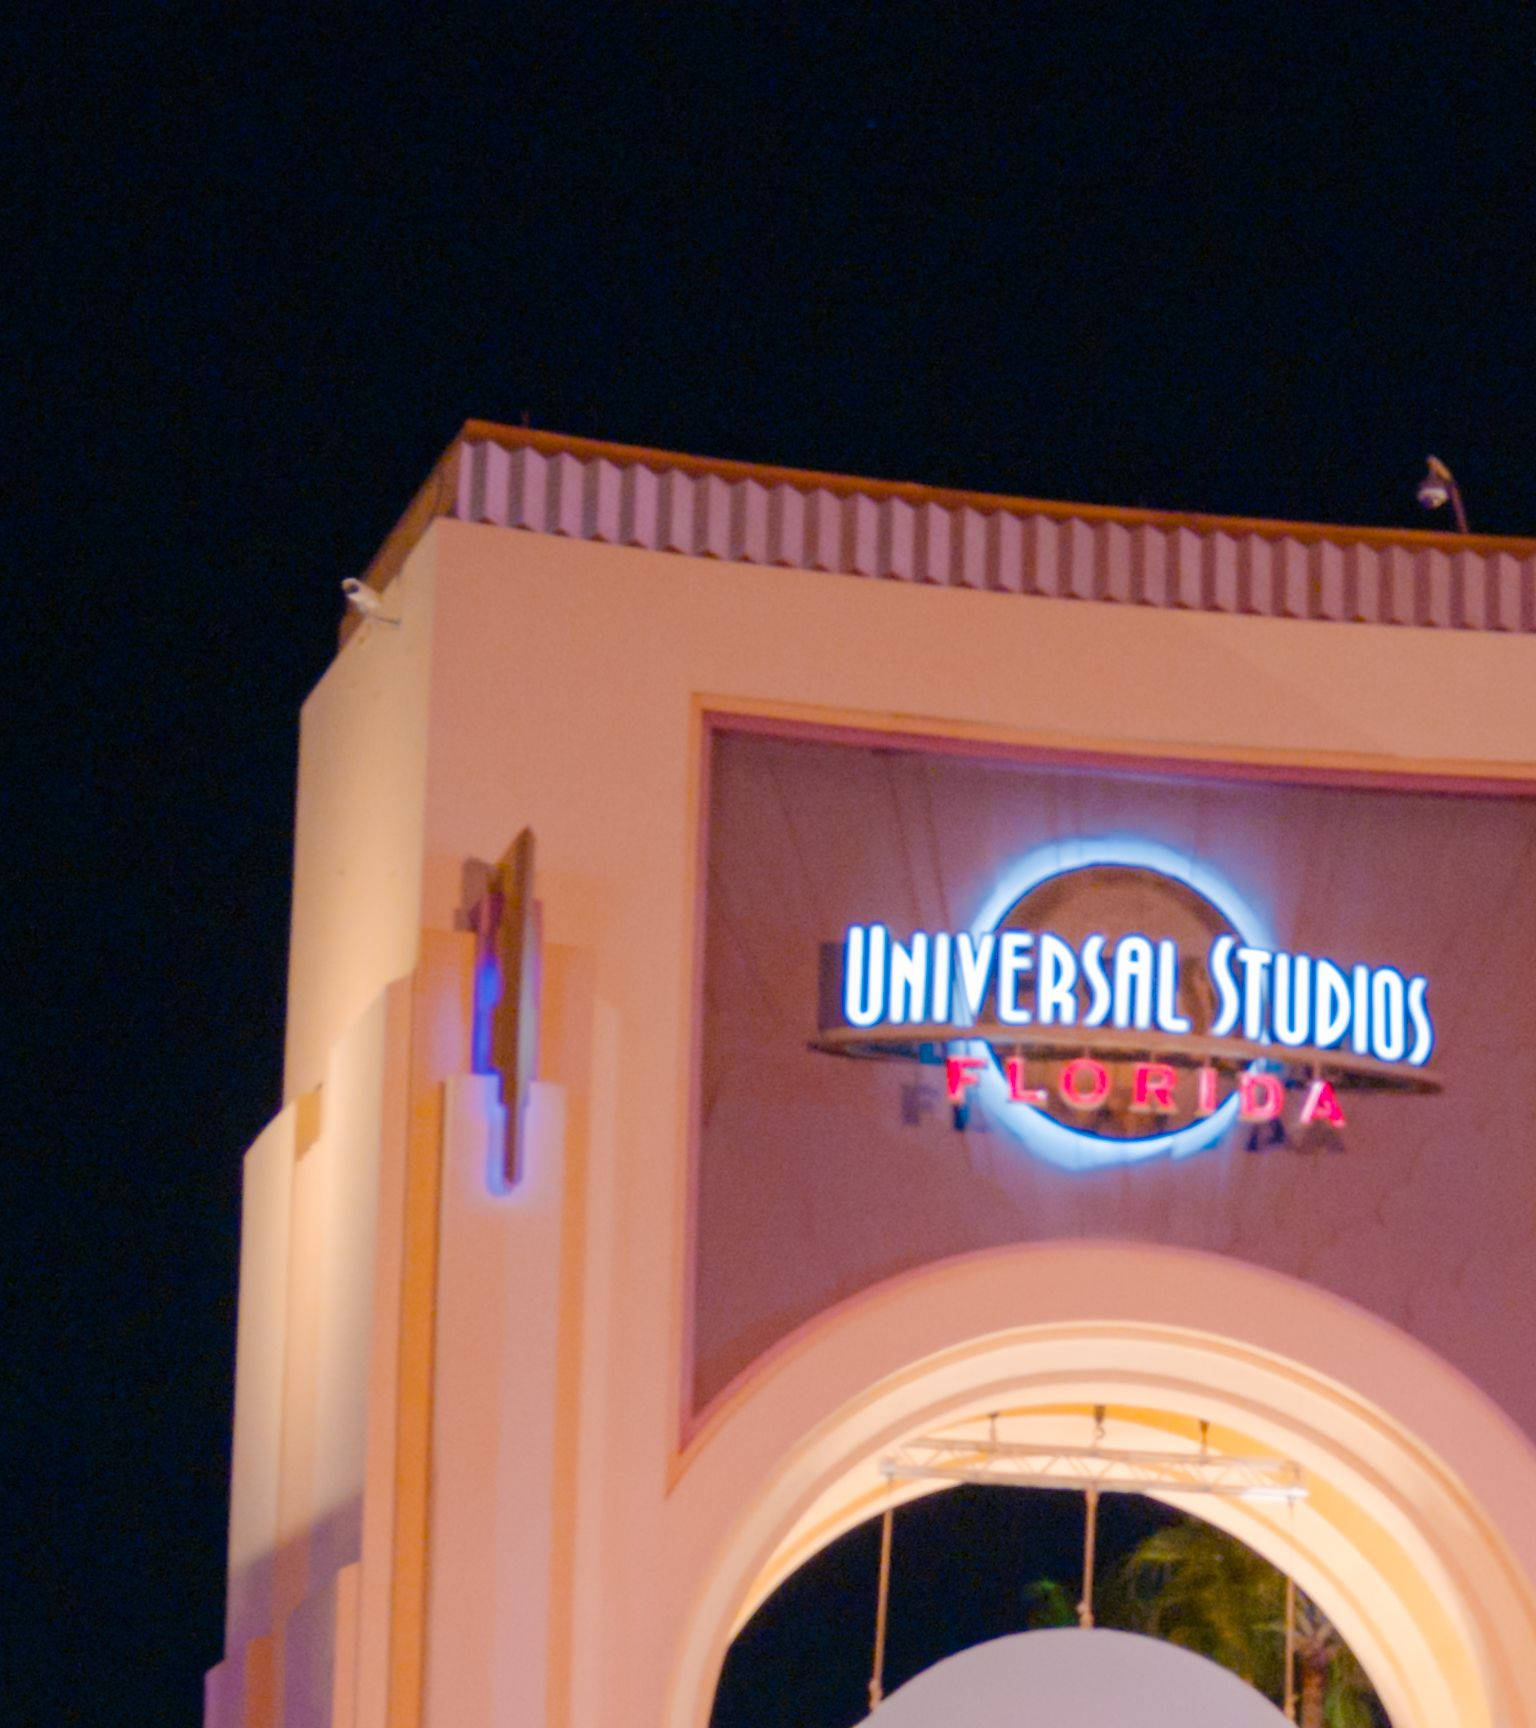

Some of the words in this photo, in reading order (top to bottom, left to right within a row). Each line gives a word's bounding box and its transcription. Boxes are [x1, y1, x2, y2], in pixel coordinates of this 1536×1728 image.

[843, 923, 1190, 1034] UNIVERSAL
[1208, 935, 1435, 1066] STUDIOS
[945, 1056, 1346, 1128] FLORIDA
